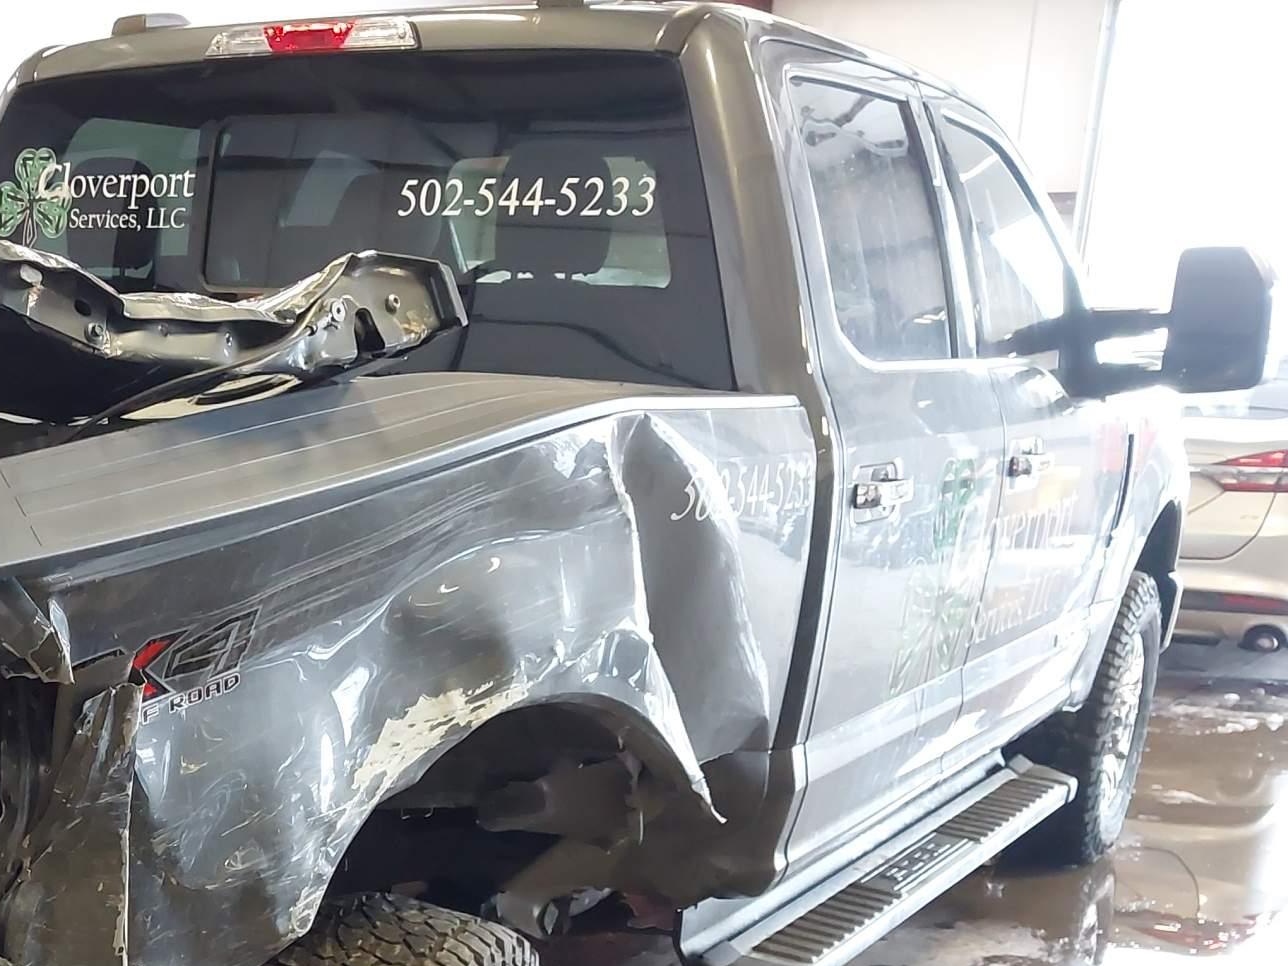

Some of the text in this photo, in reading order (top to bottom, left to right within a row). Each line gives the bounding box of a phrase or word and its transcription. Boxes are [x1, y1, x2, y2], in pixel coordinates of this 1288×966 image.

[35, 161, 196, 210] Cloverport
[397, 176, 656, 217] 502-544-5233
[69, 207, 187, 232] Services, LLC
[168, 672, 241, 714] ROAD
